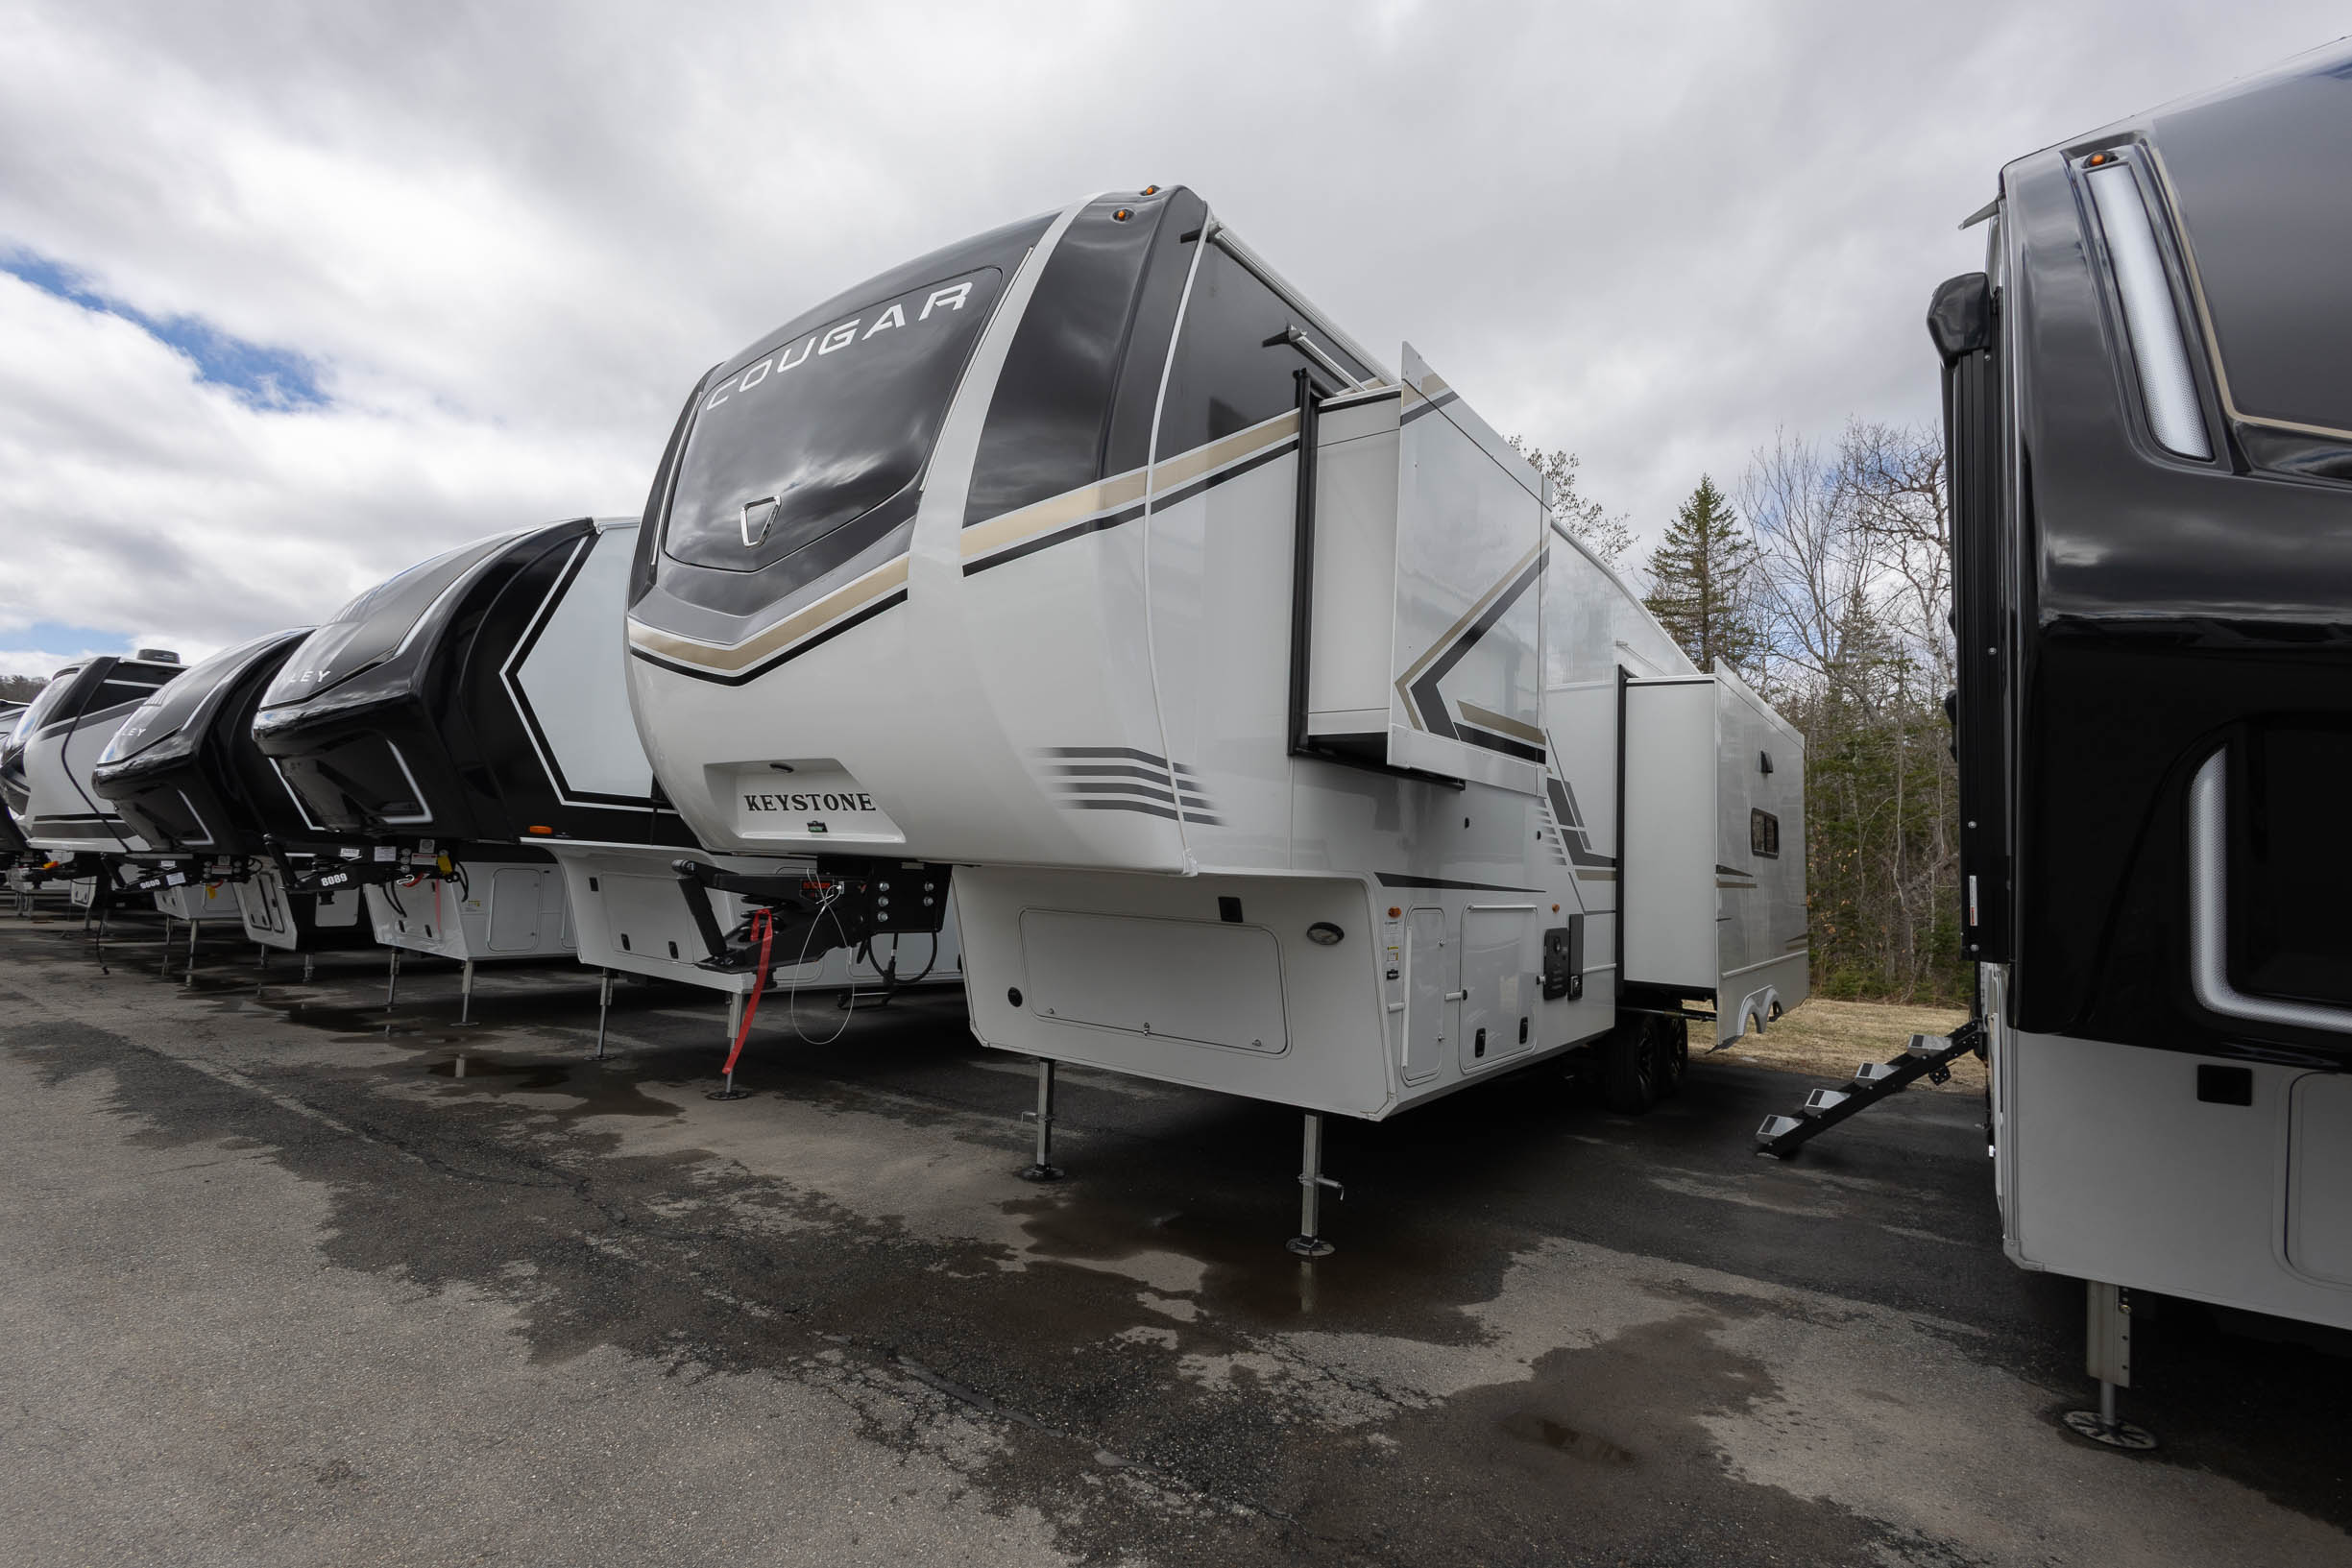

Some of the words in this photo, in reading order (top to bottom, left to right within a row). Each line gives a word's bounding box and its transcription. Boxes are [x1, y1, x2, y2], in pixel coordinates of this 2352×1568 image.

[706, 282, 973, 411] COUGAR
[743, 793, 877, 811] KEYSTONE
[321, 873, 348, 886] 8089
